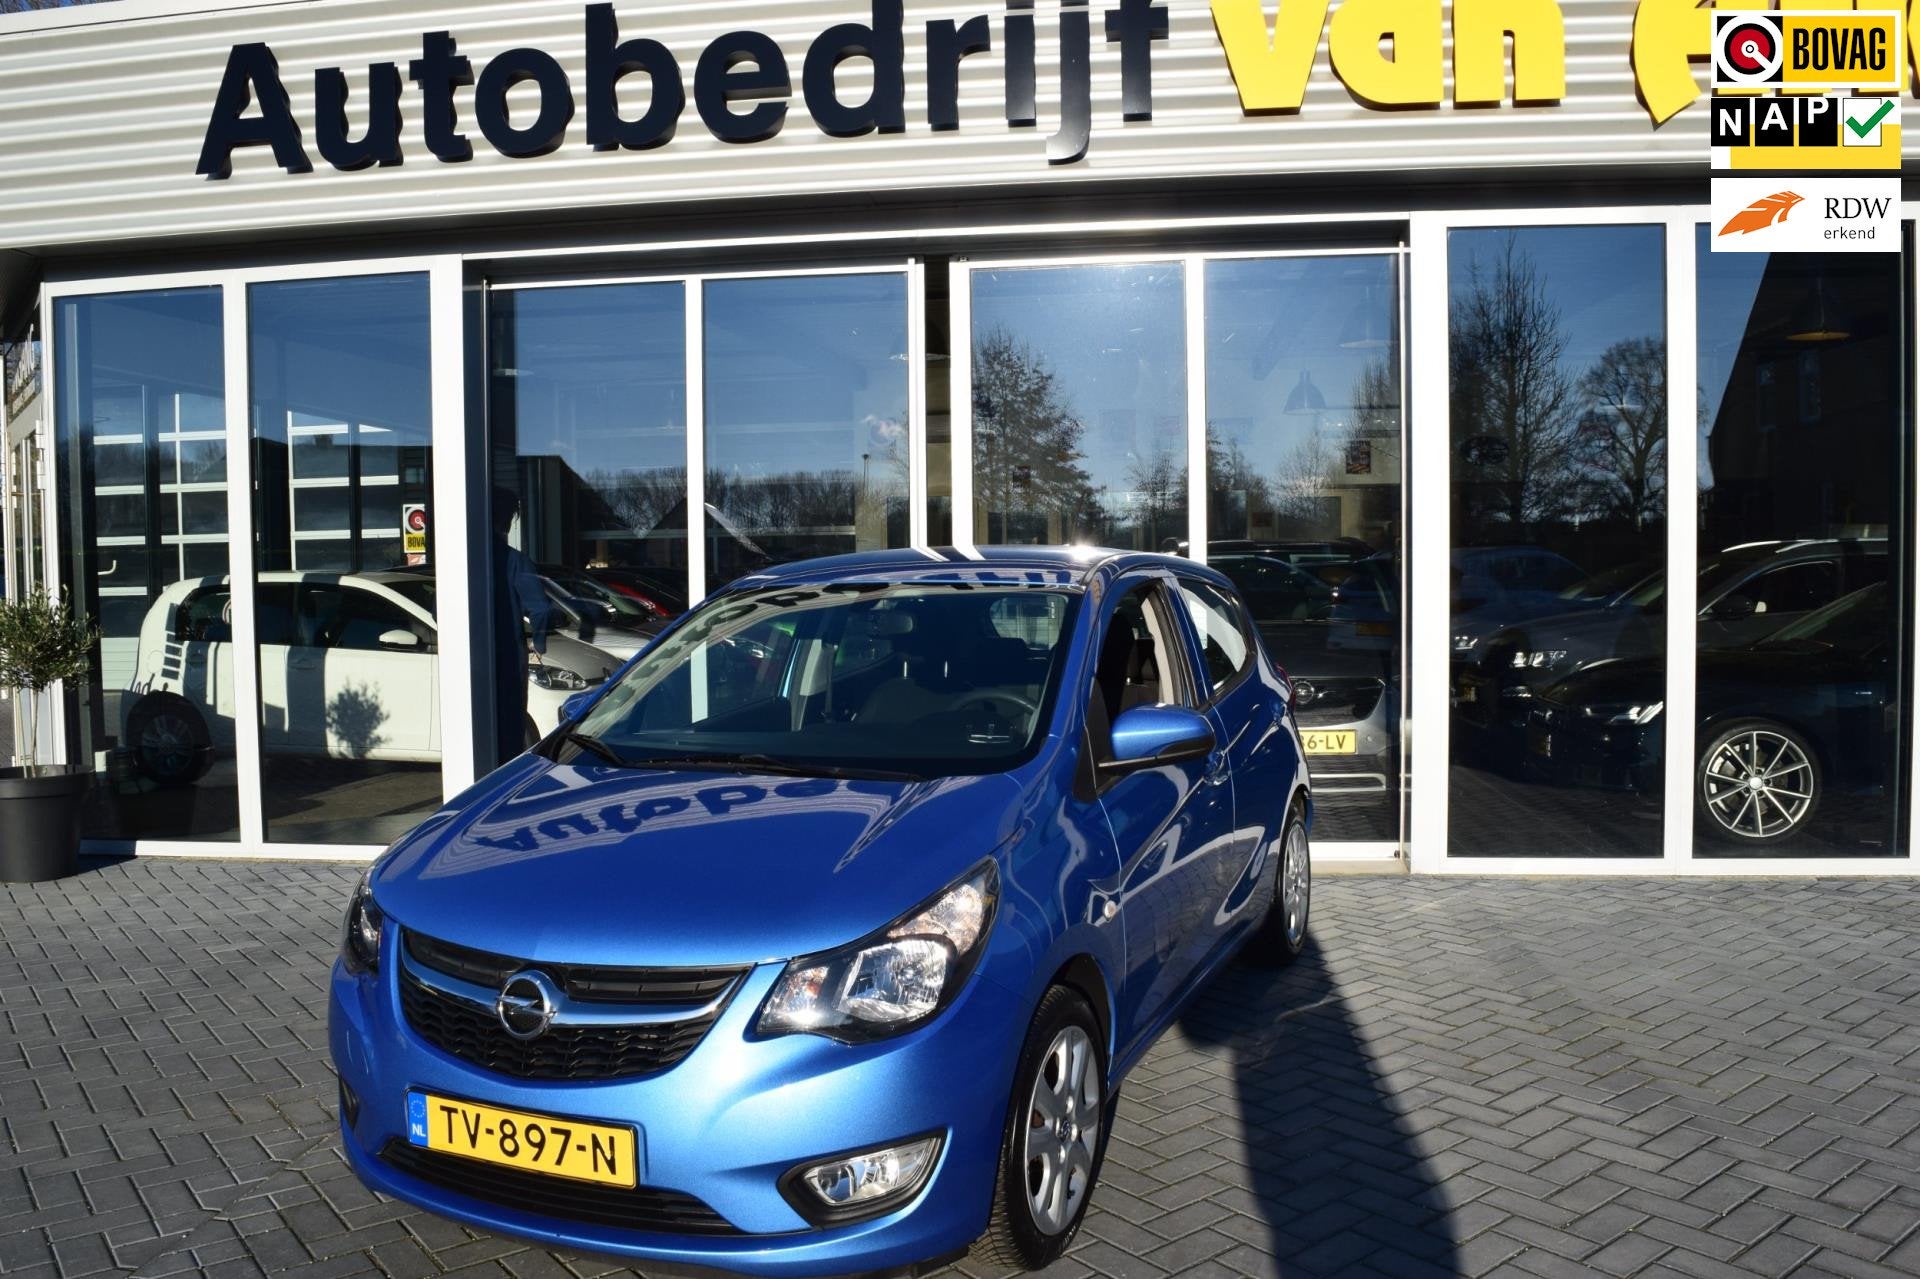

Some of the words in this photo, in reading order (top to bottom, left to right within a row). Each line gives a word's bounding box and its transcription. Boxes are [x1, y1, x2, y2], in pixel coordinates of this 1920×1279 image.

[196, 0, 1169, 180] Autobedrijf
[407, 536, 427, 548] BOVA
[412, 1124, 426, 1137] NL
[440, 1105, 617, 1175] TV-897-N
